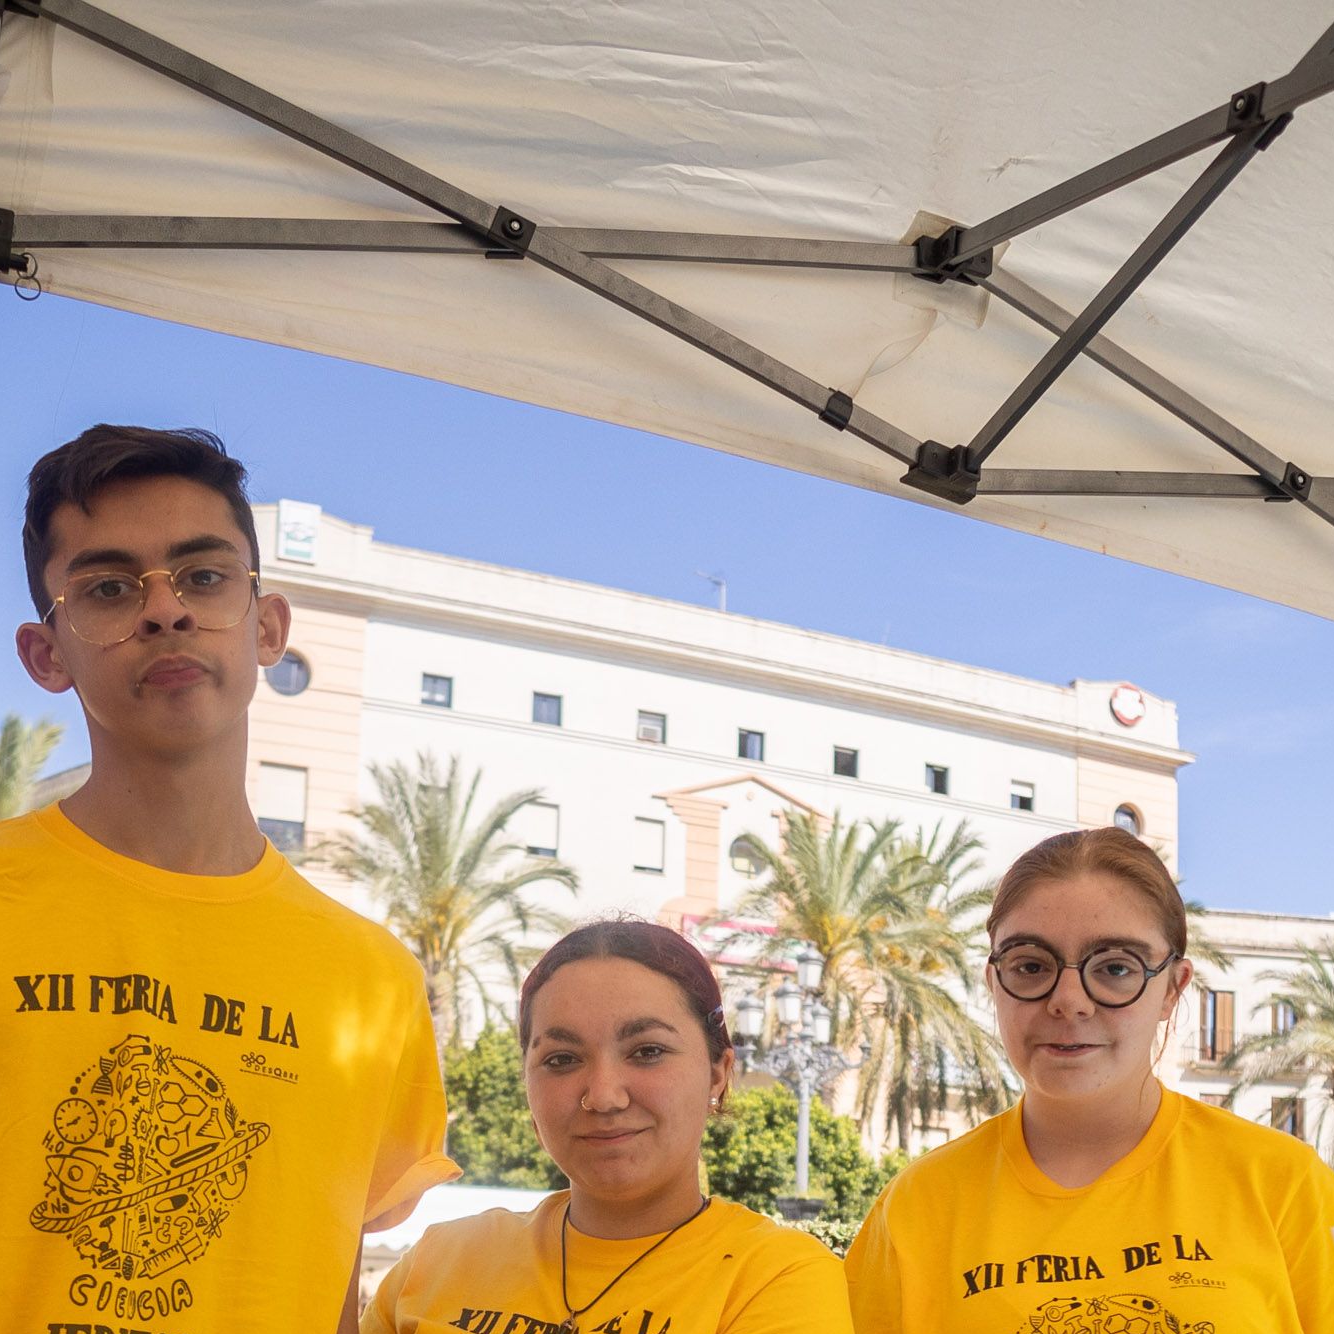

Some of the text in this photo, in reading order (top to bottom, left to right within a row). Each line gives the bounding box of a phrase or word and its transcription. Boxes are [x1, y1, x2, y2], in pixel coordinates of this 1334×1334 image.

[13, 973, 300, 1049] XII FERIA DE LA
[51, 1198, 70, 1214] Na
[962, 1234, 1213, 1299] XII FERIA DE LA
